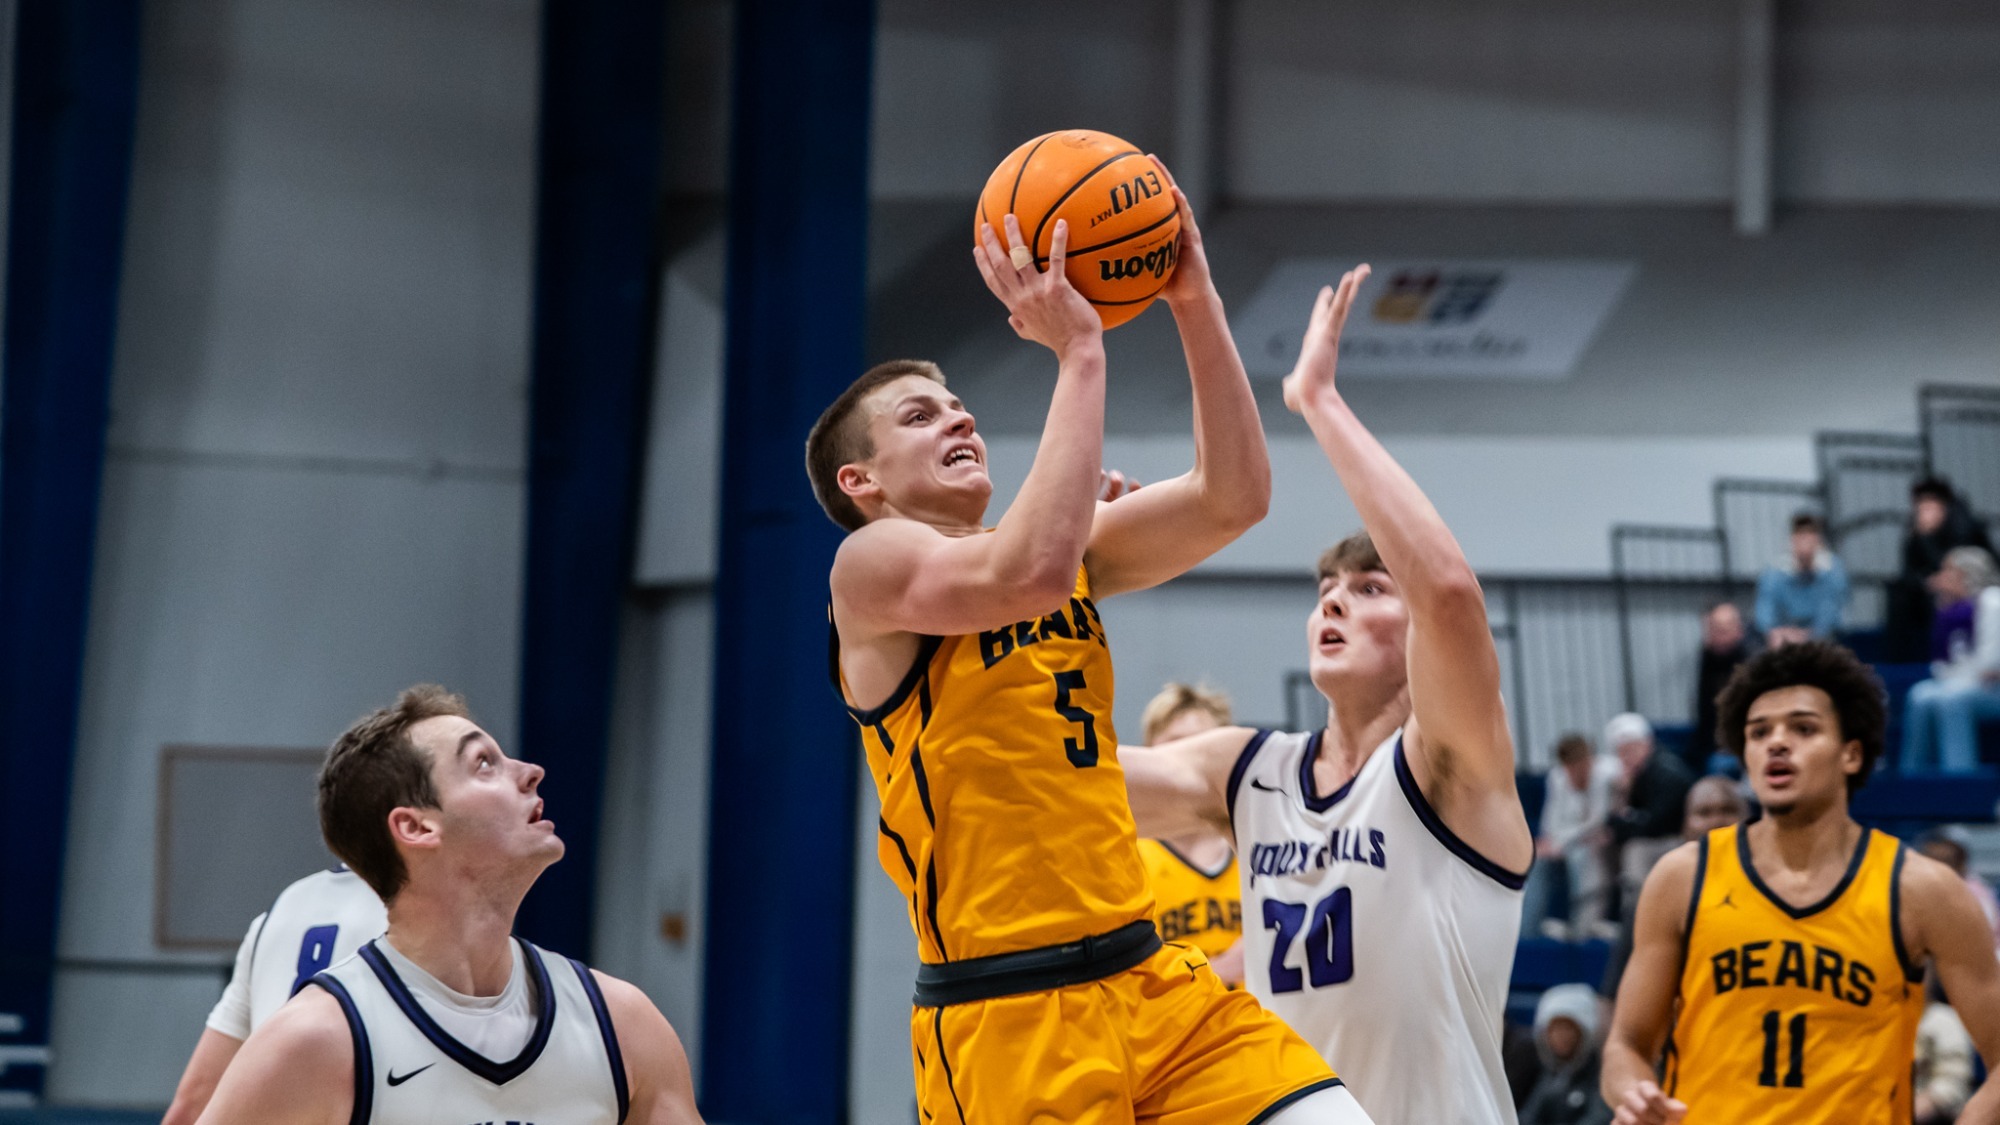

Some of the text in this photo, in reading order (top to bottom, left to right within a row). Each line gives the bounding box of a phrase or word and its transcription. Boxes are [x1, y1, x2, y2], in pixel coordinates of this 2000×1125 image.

[1090, 170, 1163, 229] EVO NXT
[1099, 232, 1181, 281] ilson
[1053, 670, 1099, 768] 5
[1160, 897, 1242, 943] BEAR
[1262, 886, 1354, 995] 20
[1711, 940, 1876, 1007] BEARS
[1758, 1010, 1807, 1088] 11
